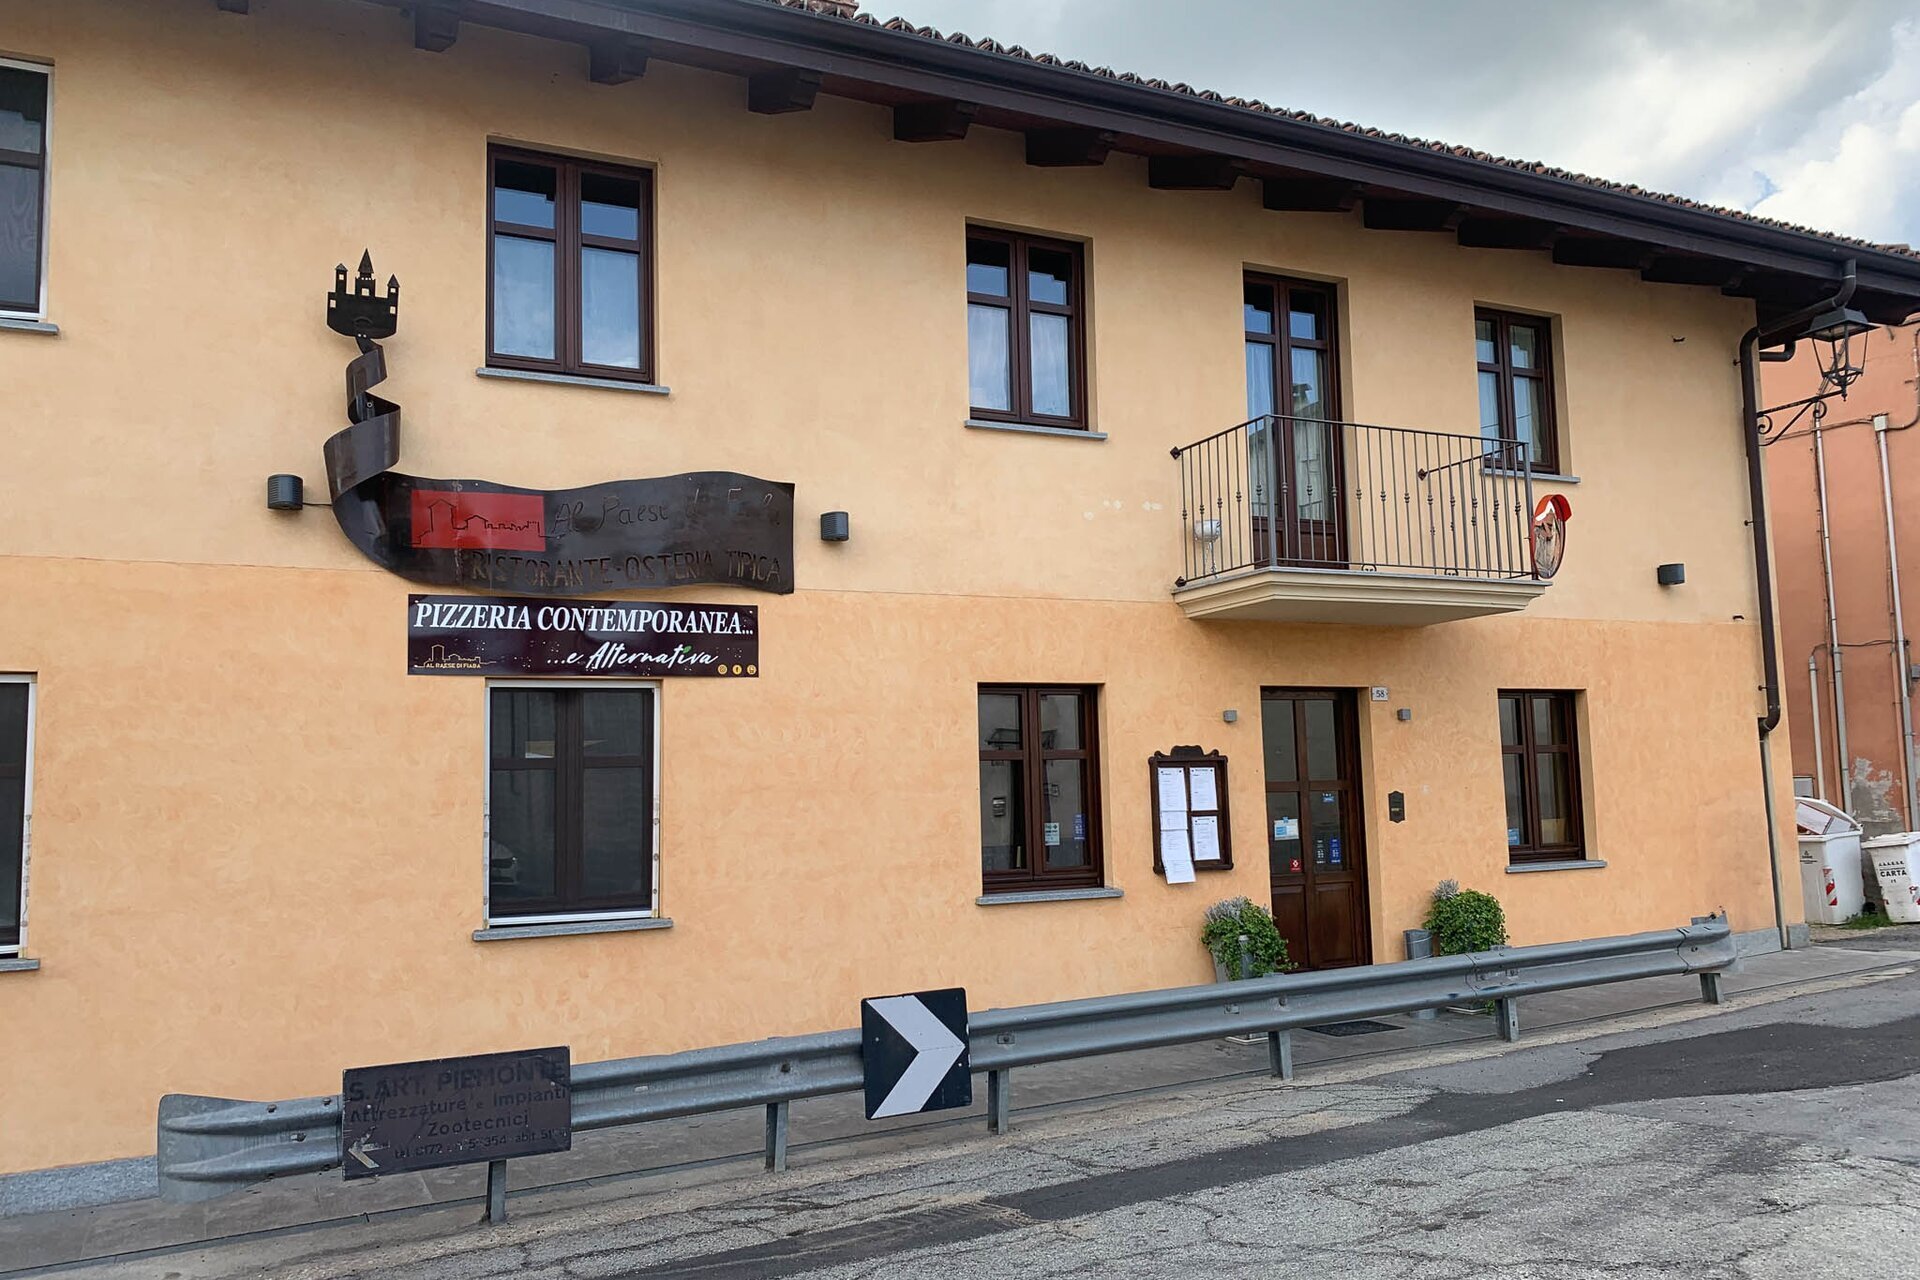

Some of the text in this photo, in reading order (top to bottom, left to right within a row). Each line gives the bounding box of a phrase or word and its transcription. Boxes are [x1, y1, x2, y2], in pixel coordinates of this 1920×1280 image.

[727, 550, 781, 584] TIPICA
[413, 602, 754, 636] PIZZERIA CONTEMPORANEA...
[585, 641, 719, 670] Alternativa
[1376, 690, 1385, 698] 58
[1880, 869, 1907, 878] CARTA
[438, 1060, 566, 1092] PIEMONTE
[350, 1098, 467, 1123] Attrezzature
[493, 1087, 567, 1111] Impianti
[427, 1114, 529, 1138] Zootecnici
